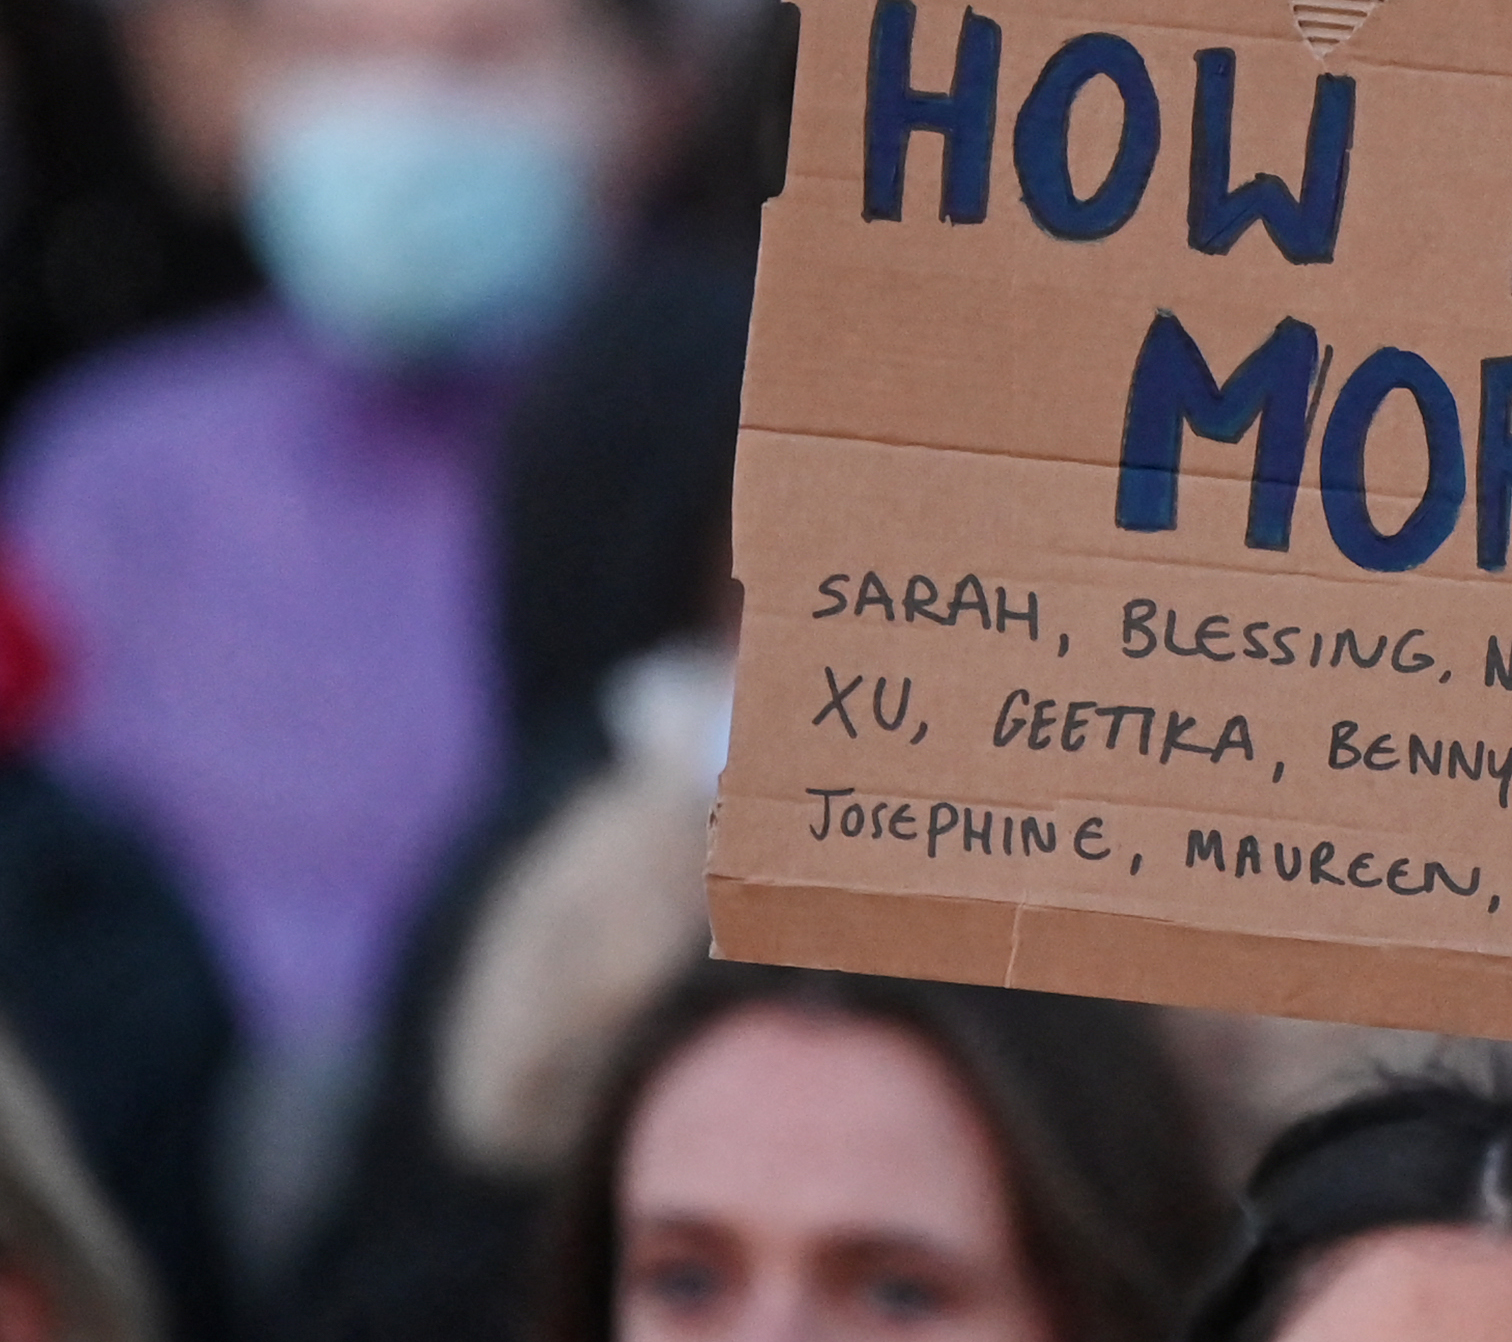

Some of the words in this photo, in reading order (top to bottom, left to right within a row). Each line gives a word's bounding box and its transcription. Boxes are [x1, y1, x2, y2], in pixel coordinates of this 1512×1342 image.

[810, 571, 1071, 660] SARAH,
[1120, 596, 1454, 686] BLESSING,
[809, 664, 930, 747] XU,
[991, 686, 1287, 786] GEETIKA,
[803, 785, 1145, 878] JOSEPHINE,
[1183, 827, 1502, 916] MAUREEN,
